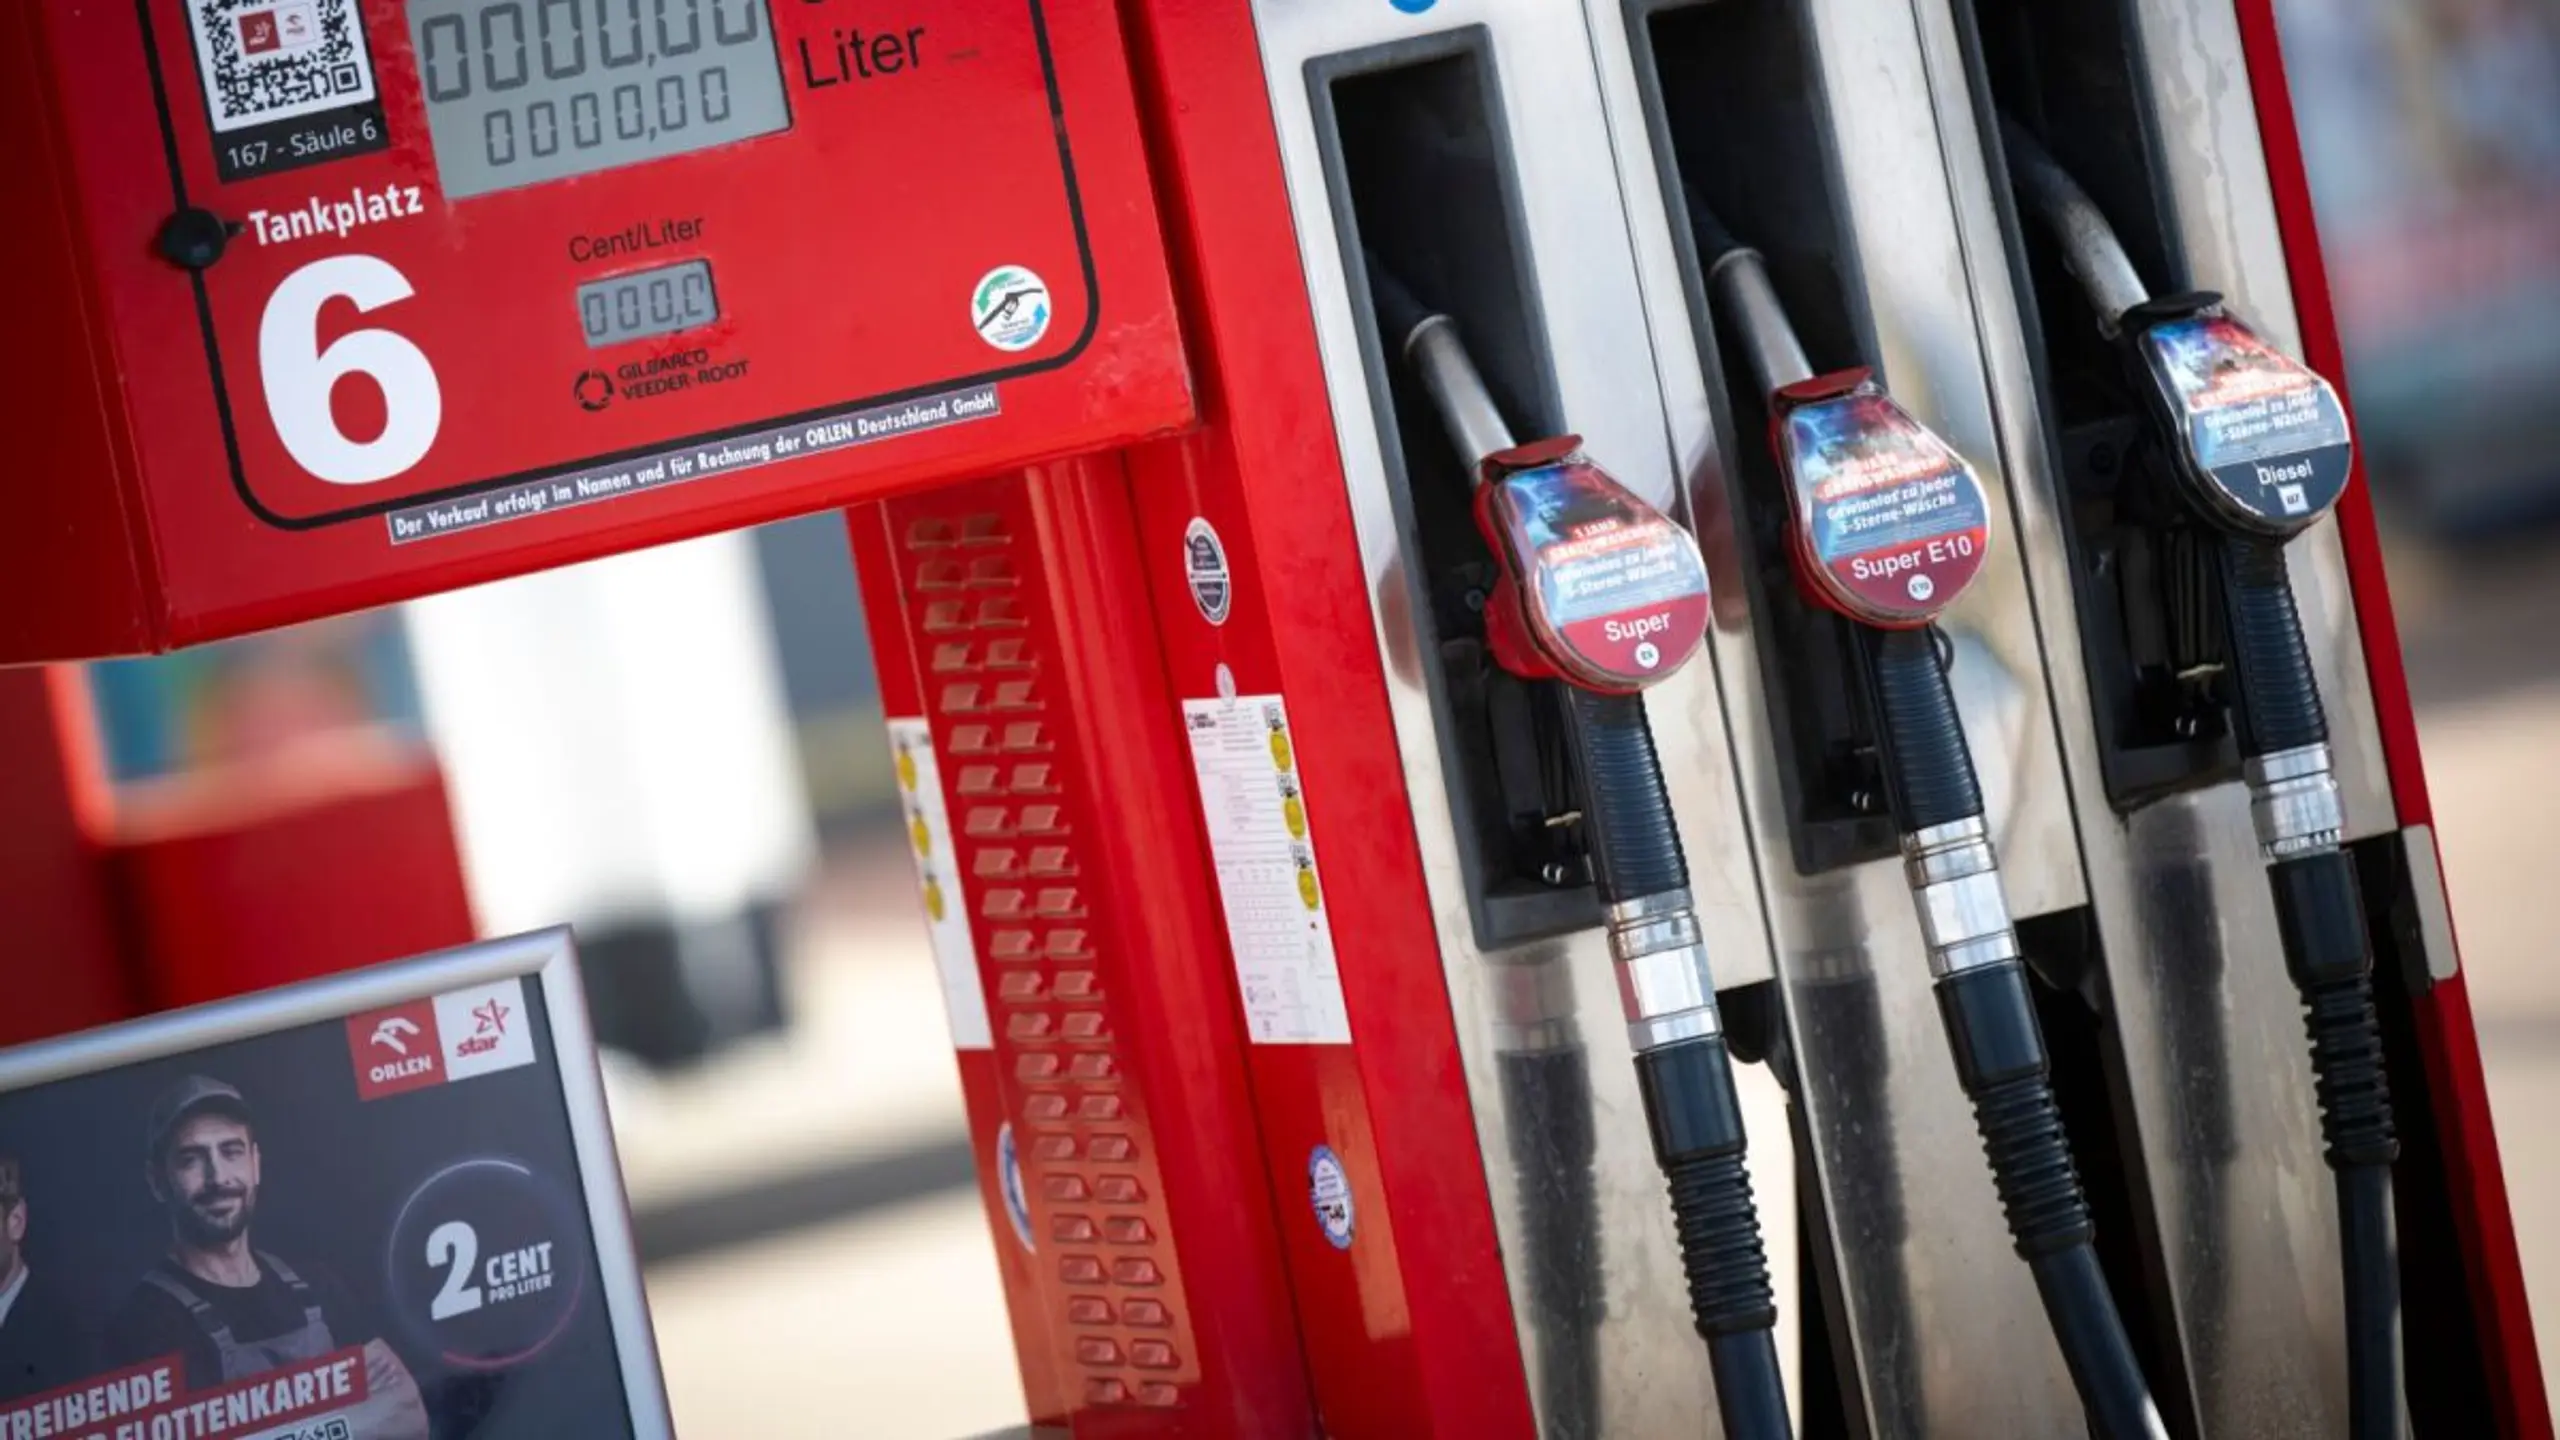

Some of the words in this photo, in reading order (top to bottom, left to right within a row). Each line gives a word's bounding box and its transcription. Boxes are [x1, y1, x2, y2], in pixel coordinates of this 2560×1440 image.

[798, 25, 925, 88] Liter
[484, 66, 730, 166] 0000,00
[229, 141, 269, 169] 167
[290, 126, 356, 157] Säule
[361, 118, 377, 141] 6
[248, 184, 424, 246] Tankplatz
[568, 217, 704, 262] Cent/Liter
[259, 254, 442, 485] 6
[617, 349, 709, 379] GILBARCO
[396, 517, 423, 536] Der
[427, 501, 488, 532] Verkauf
[495, 490, 548, 514] erfolgt
[552, 484, 573, 503] im
[577, 472, 631, 498] Namen
[637, 460, 665, 483] und
[670, 455, 693, 475] für
[698, 441, 771, 471] Rechnung
[775, 435, 802, 454] der
[805, 421, 853, 448] ORLEN
[857, 401, 948, 437] Deutschland
[952, 391, 996, 415] GmbH
[2257, 458, 2314, 486] Diesel
[1851, 549, 1921, 579] Super
[1926, 535, 1972, 563] E10
[1604, 611, 1672, 641] Super
[369, 1055, 433, 1083] ORLEN
[457, 1036, 499, 1057] star
[426, 1219, 482, 1321] 2
[486, 1241, 552, 1287] CENT
[489, 1283, 516, 1304] PRO
[0, 1367, 173, 1440] TREIBENDE
